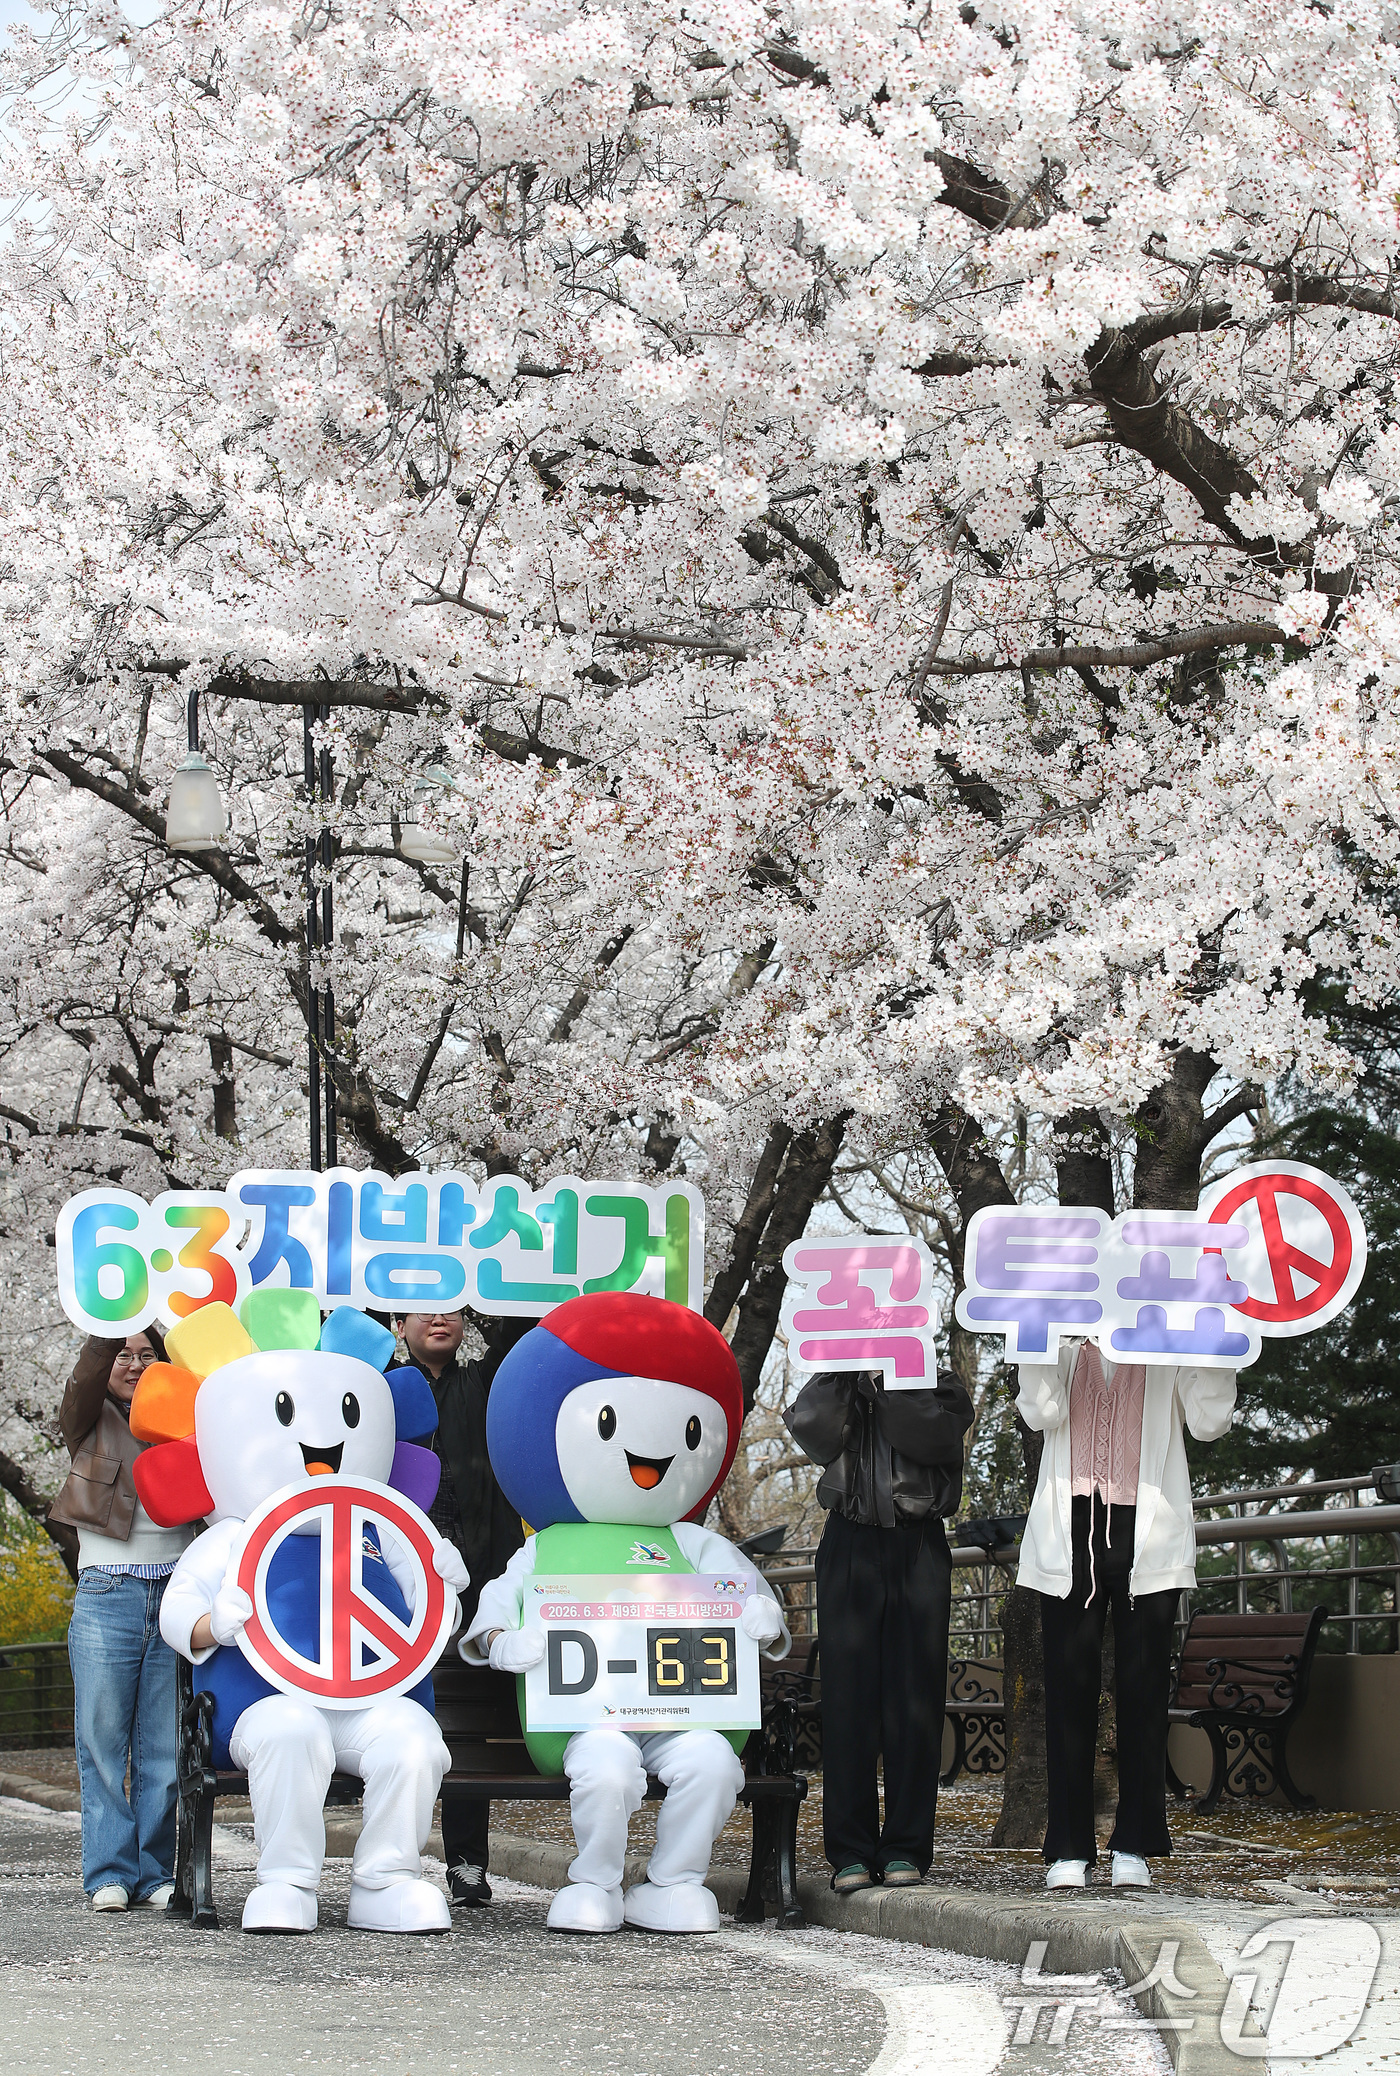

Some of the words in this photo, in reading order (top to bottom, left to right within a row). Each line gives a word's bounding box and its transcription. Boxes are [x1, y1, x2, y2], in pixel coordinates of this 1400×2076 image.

[240, 1181, 689, 1307] 지방선거
[966, 1216, 1250, 1356] 투표
[793, 1246, 929, 1378] 꼭
[548, 1606, 581, 1618] 2026.
[583, 1605, 595, 1618] 6.
[597, 1605, 608, 1618] 3.
[611, 1604, 640, 1618] 제9회
[644, 1603, 734, 1618] 전국동시지방선거
[619, 1706, 691, 1716] 대구광역시선거관리위원회
